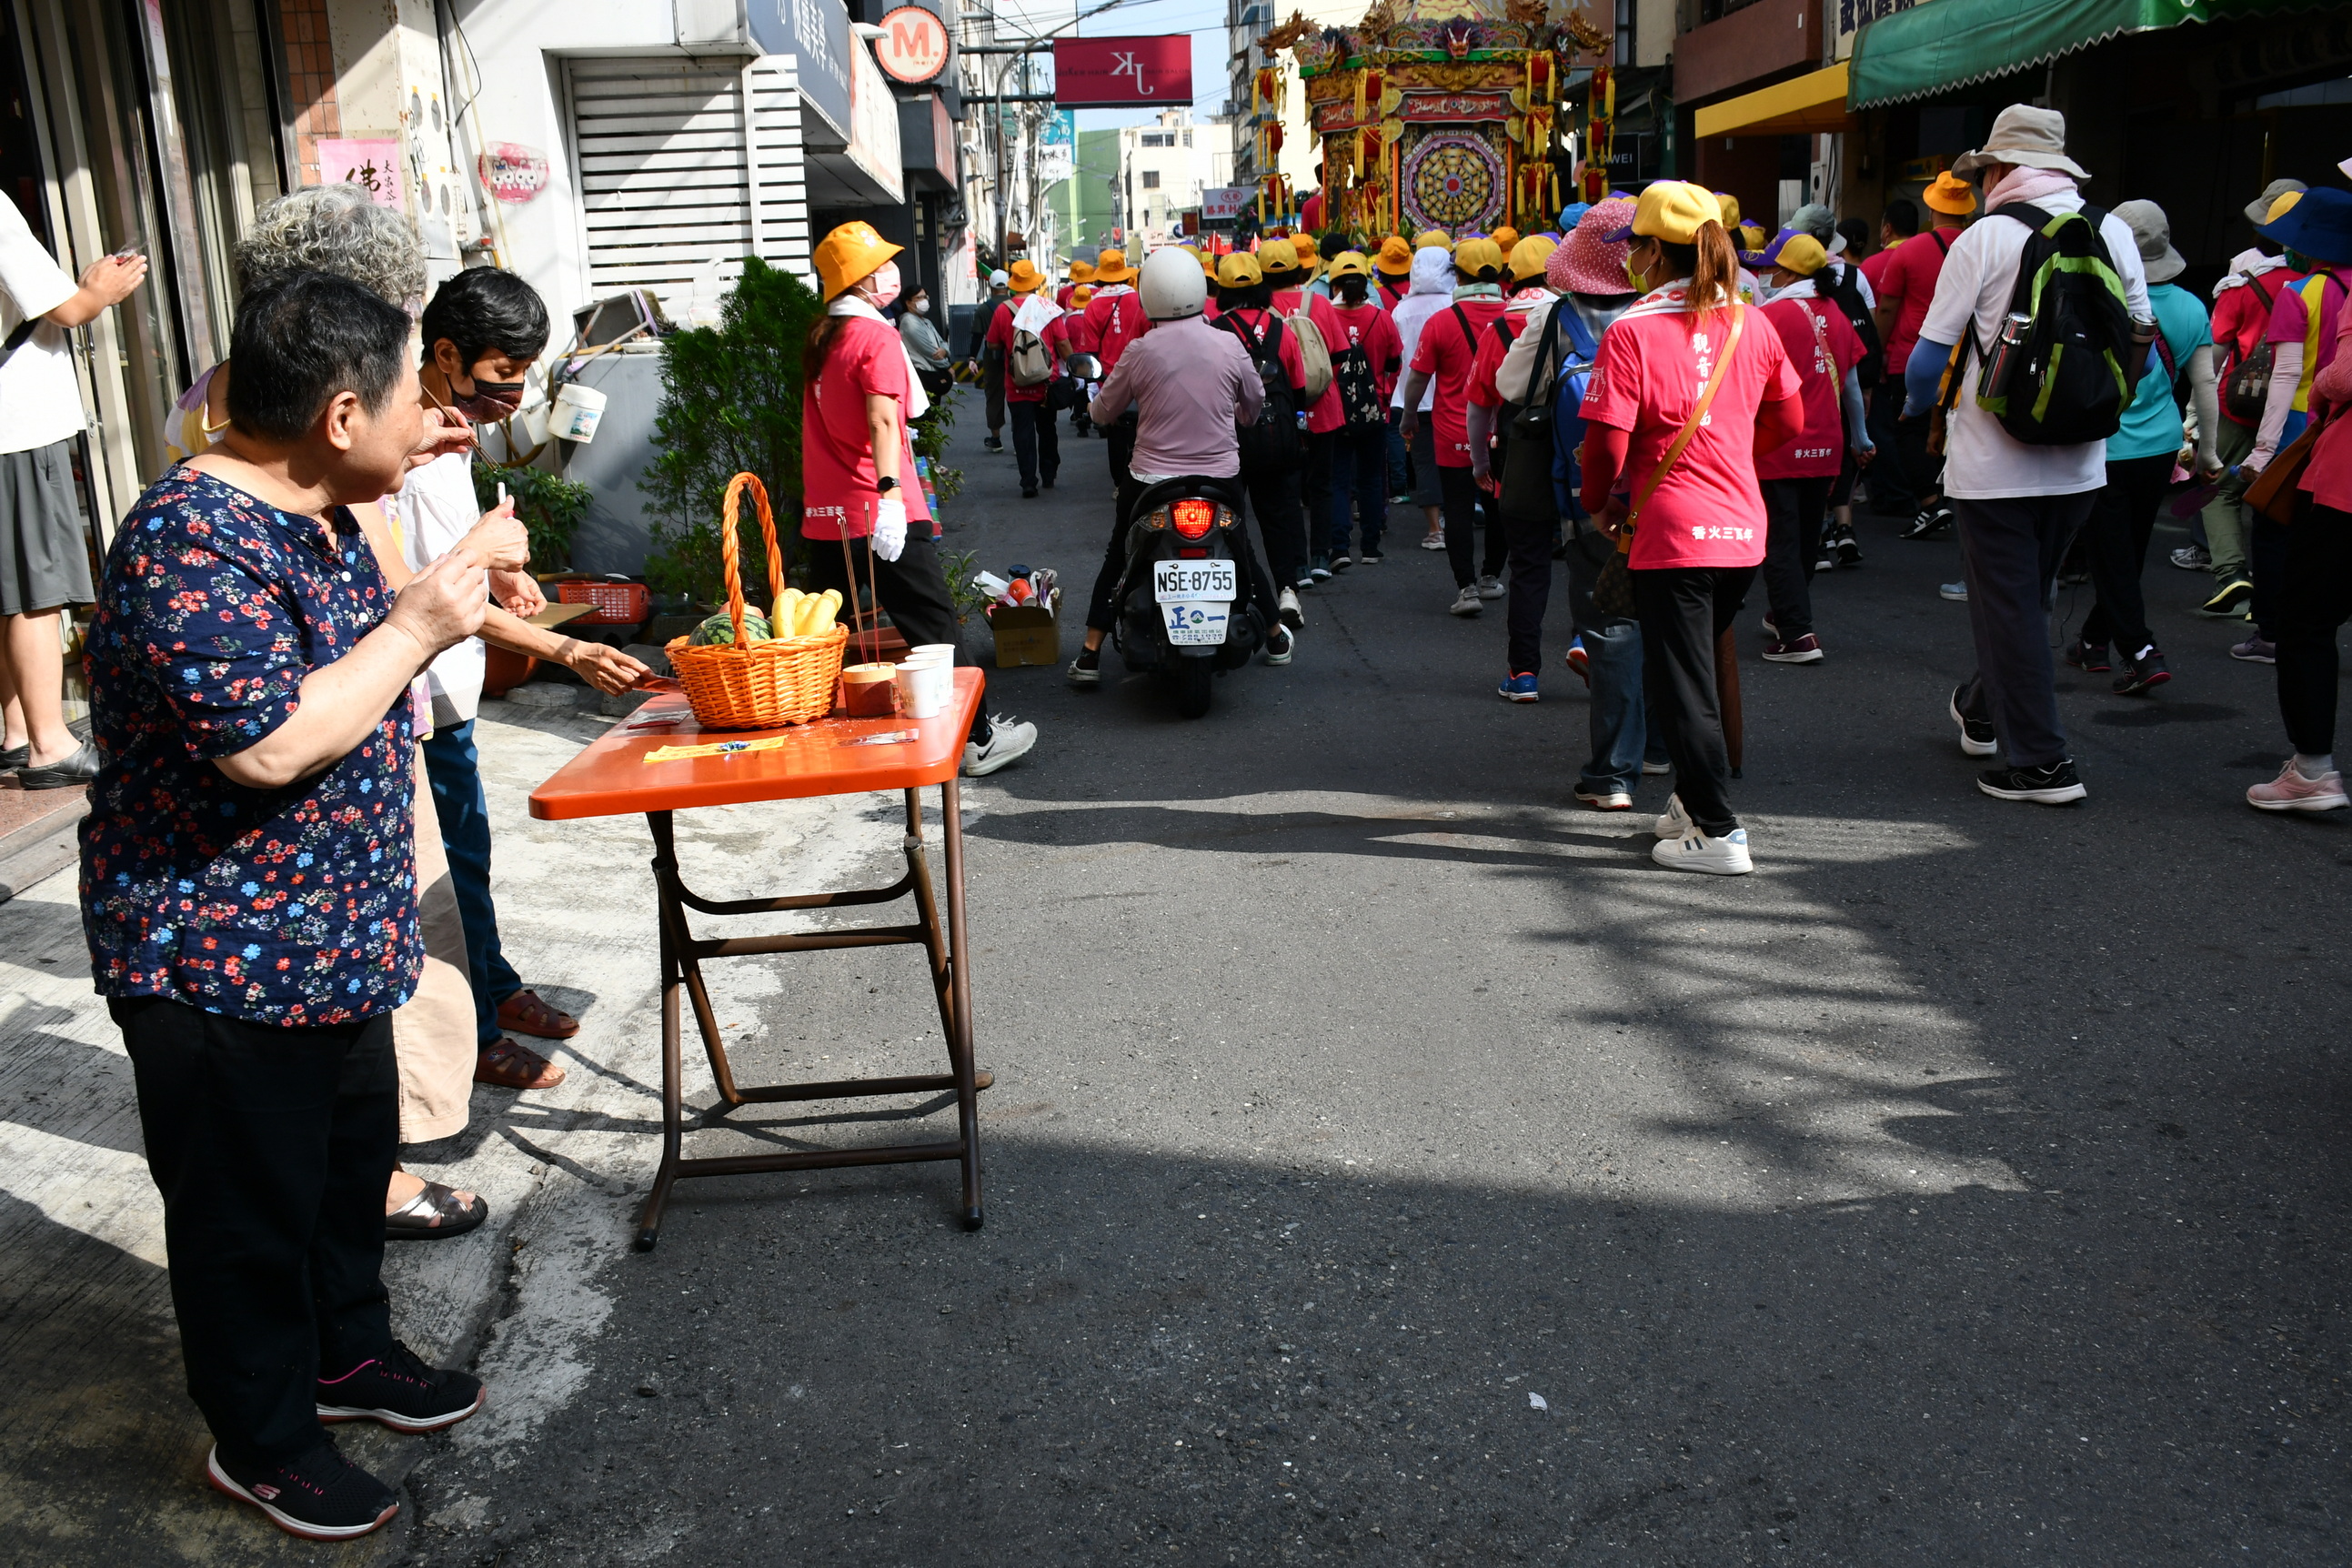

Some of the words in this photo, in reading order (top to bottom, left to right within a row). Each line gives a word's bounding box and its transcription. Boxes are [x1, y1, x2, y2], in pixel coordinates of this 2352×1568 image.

[1814, 315, 1827, 374] 觀賜福
[1692, 525, 1754, 543] 香火三百年
